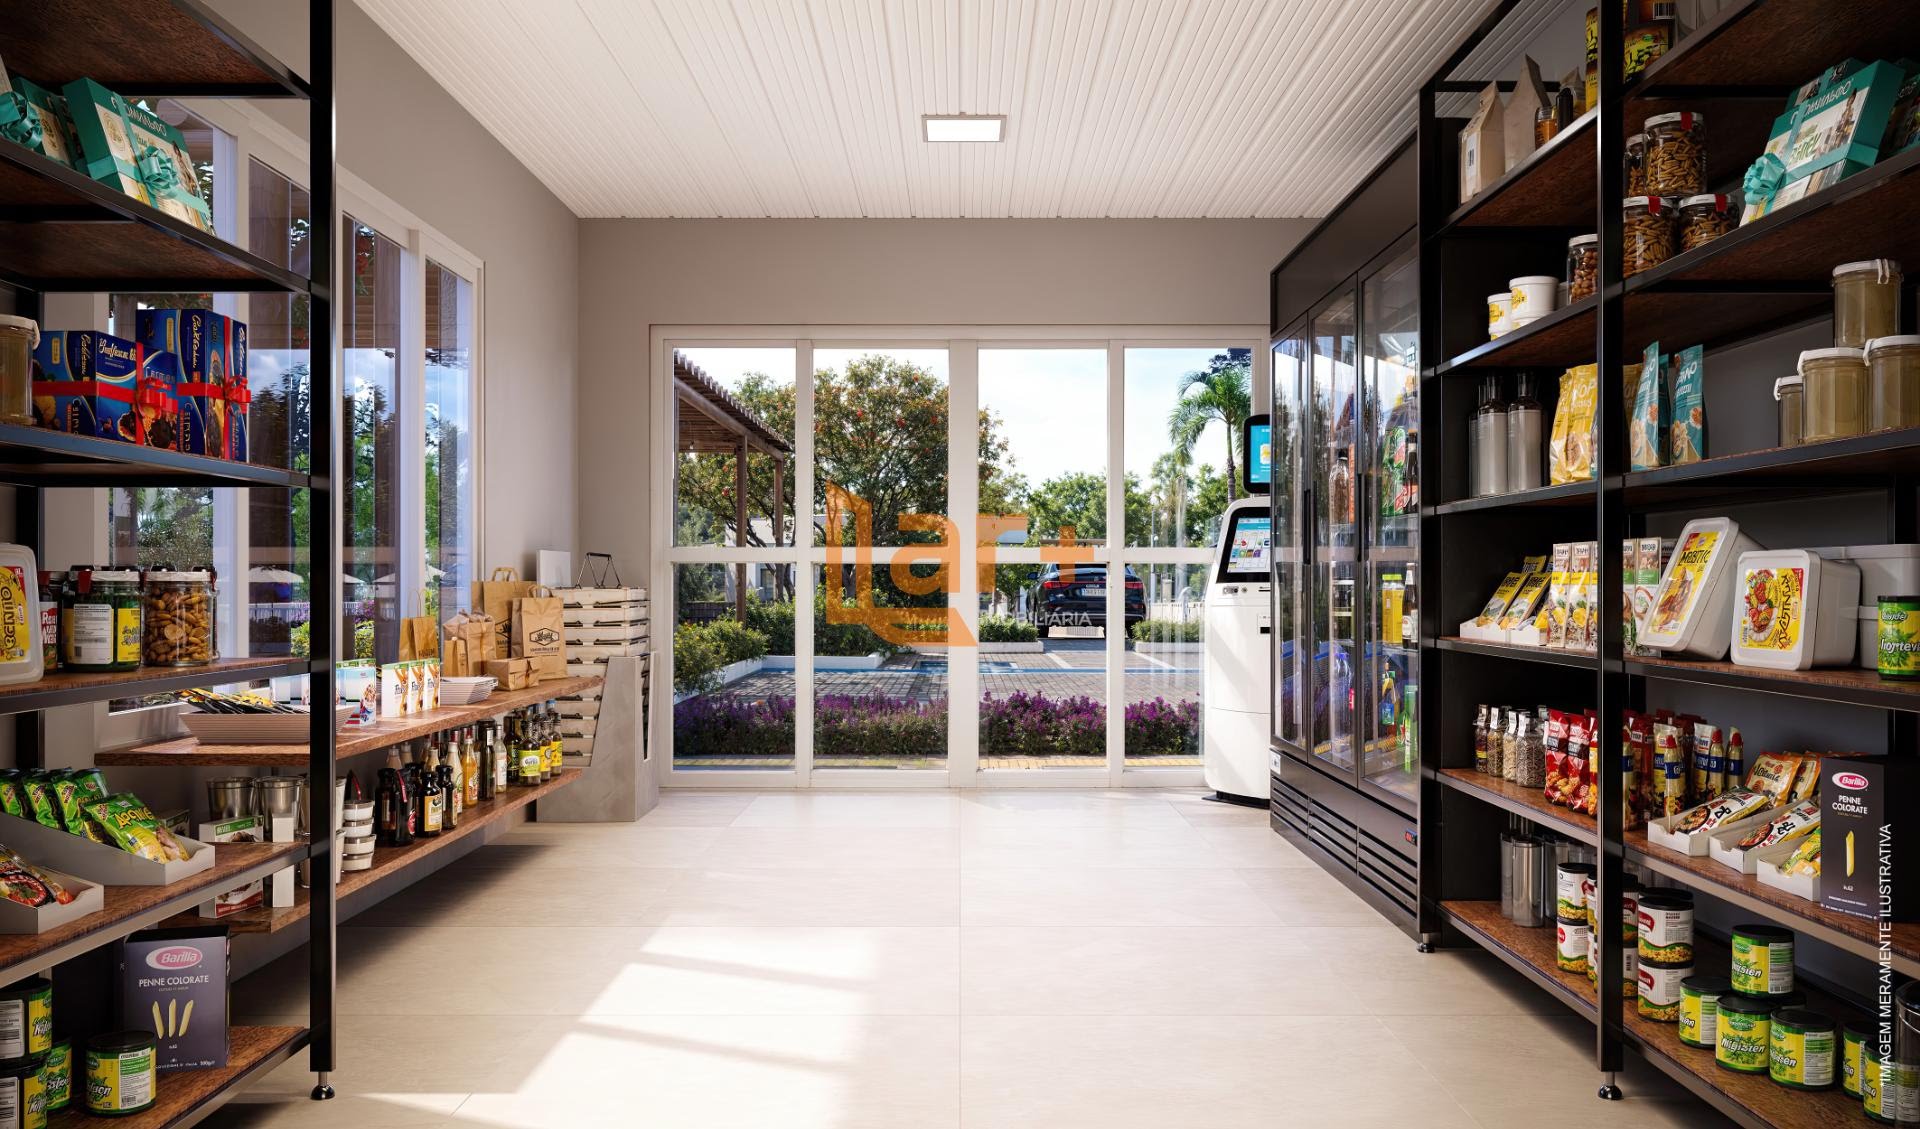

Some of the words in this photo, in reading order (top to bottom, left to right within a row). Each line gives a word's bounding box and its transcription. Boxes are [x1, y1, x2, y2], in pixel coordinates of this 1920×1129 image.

[1841, 776, 1865, 787] Barilla
[1838, 795, 1861, 805] PENNE
[1832, 802, 1868, 814] COLORATE
[161, 952, 198, 963] Barilla
[139, 978, 165, 988] PENNE
[167, 975, 209, 985] COLORATE
